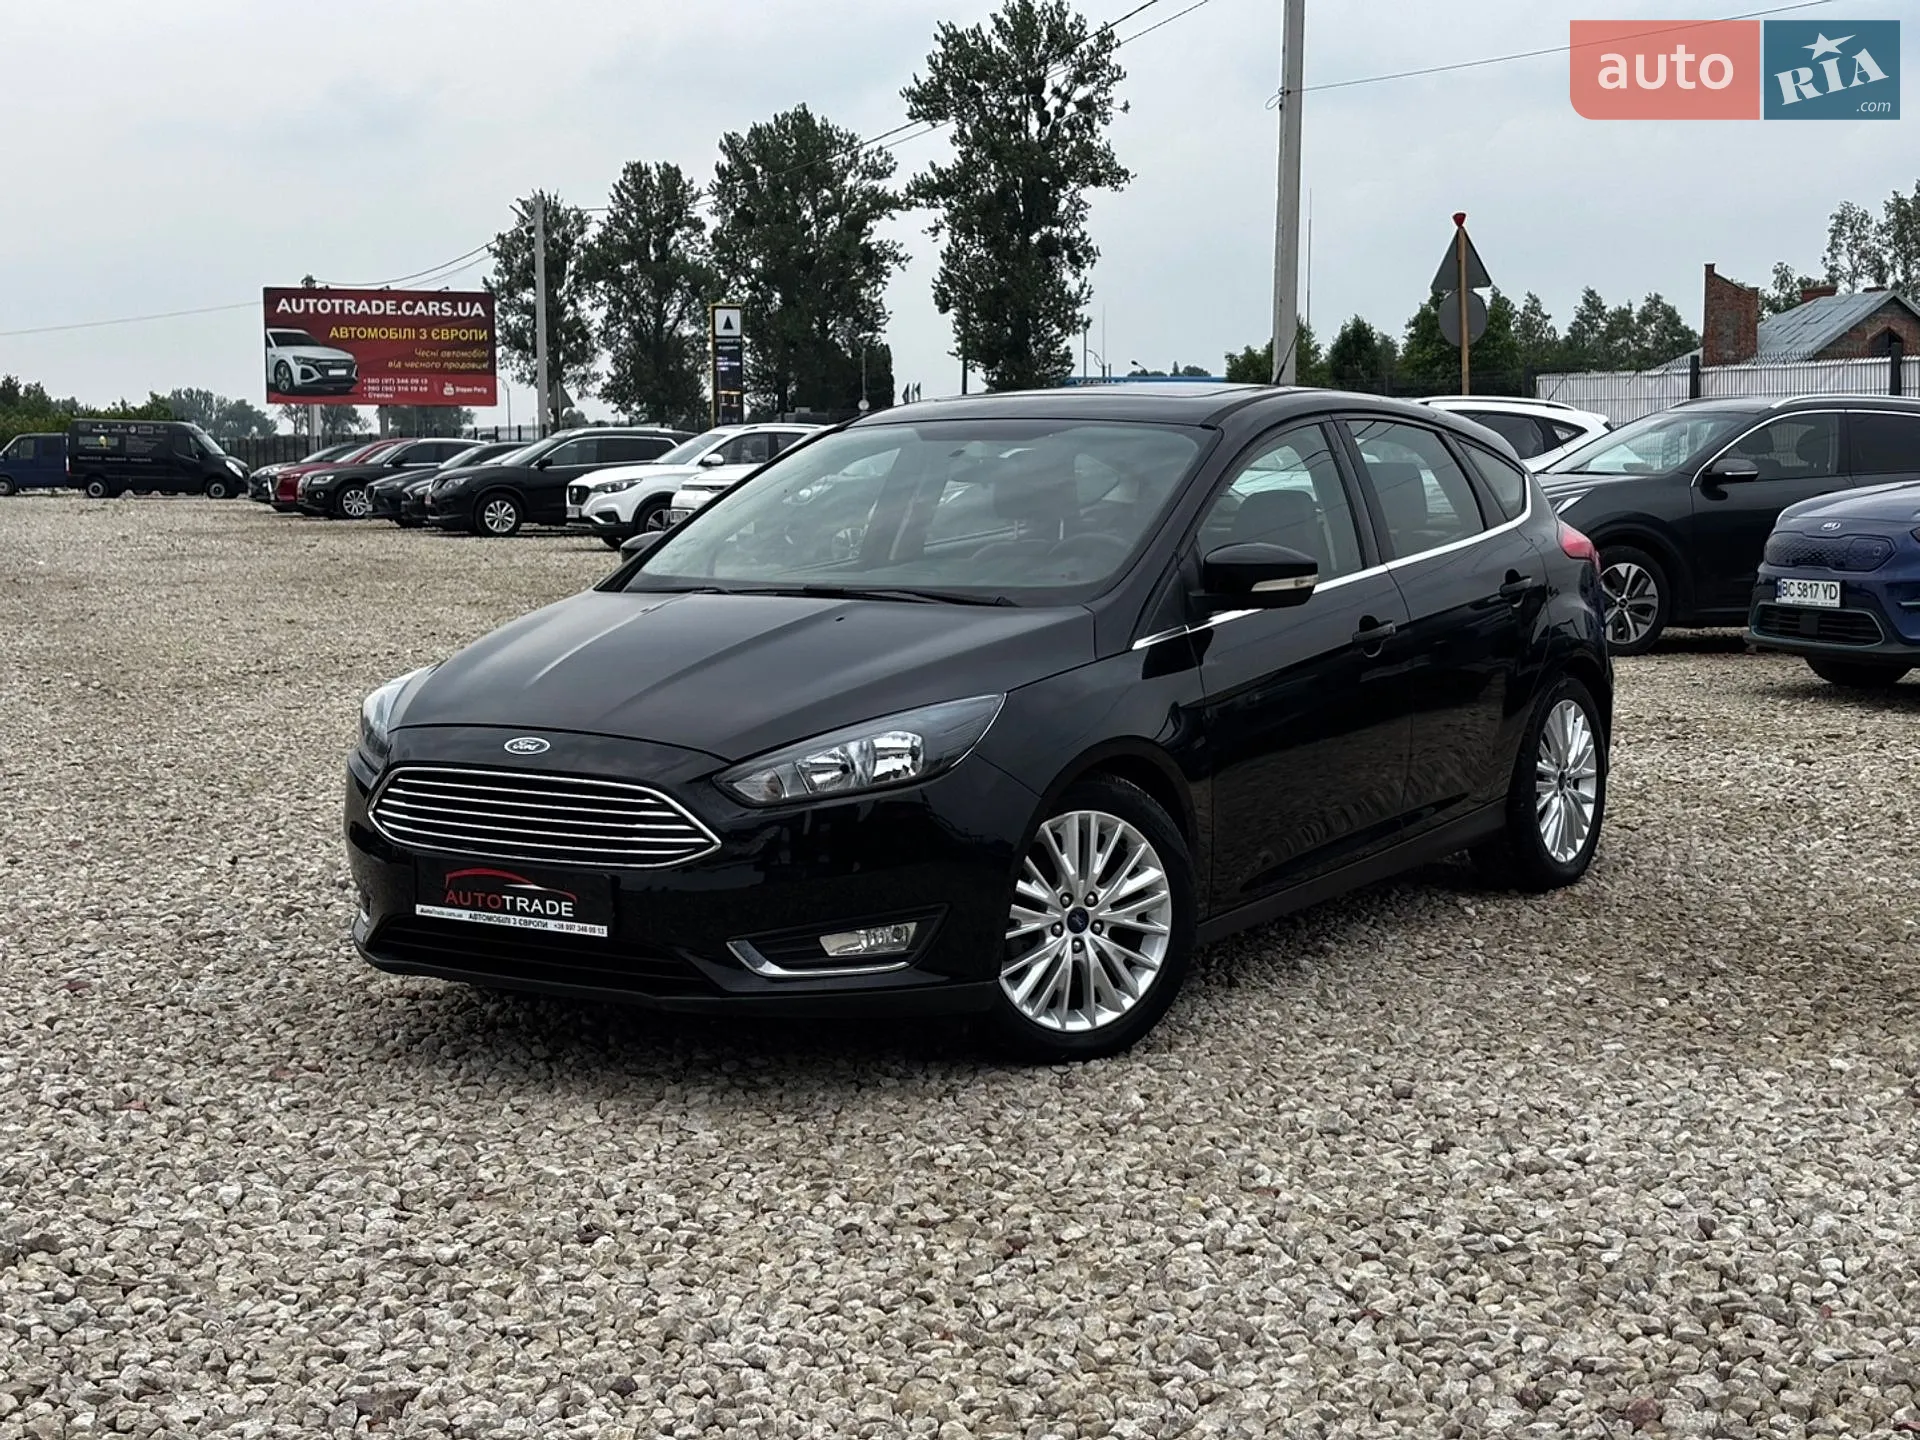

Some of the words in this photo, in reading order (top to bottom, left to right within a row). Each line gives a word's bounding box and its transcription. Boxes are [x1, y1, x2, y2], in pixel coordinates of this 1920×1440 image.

[276, 298, 485, 317] AUTOTRADE.CARS.UA
[329, 326, 415, 340] АВТОМОБІЛІ
[431, 328, 488, 341] ЄВРОПИ
[441, 347, 489, 358] автомобілі
[388, 360, 401, 369] від
[404, 361, 441, 369] чесного
[1782, 581, 1795, 597] BC
[1797, 582, 1819, 599] 5817
[1821, 583, 1838, 600] YD
[508, 738, 545, 752] Ford
[445, 889, 574, 917] AUTOTRADE
[518, 917, 548, 928] ЄВРОПИ
